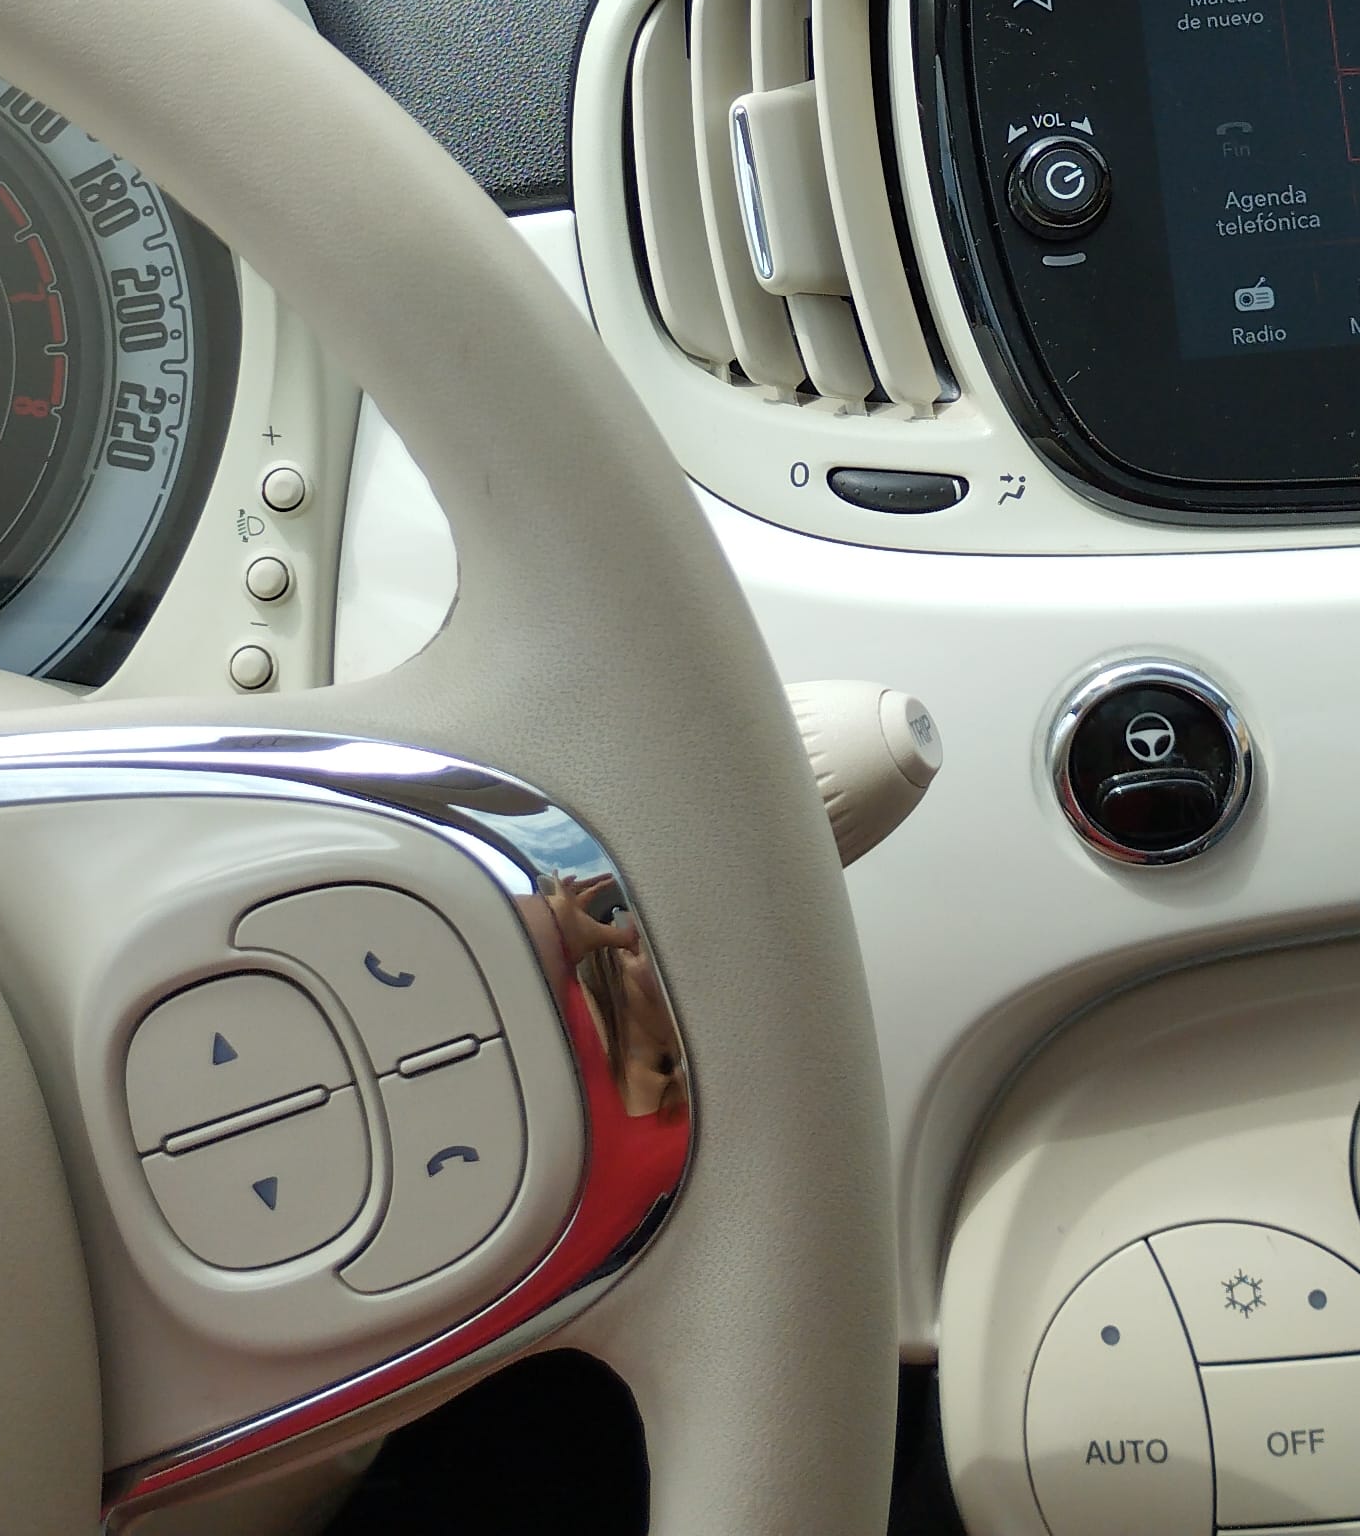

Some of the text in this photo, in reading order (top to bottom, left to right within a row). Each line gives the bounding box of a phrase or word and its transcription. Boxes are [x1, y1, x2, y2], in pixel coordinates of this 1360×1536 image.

[1177, 9, 1264, 31] de nuevo
[1032, 113, 1066, 131] VOL
[69, 159, 141, 238] 180
[1224, 184, 1307, 215] Agenda
[1216, 210, 1320, 237] telefónica
[110, 263, 168, 353] 200
[1232, 324, 1287, 346] Radio
[106, 380, 167, 472] 220
[790, 462, 809, 487] 0
[908, 713, 934, 748] TRIP
[1085, 1439, 1169, 1465] AUTO
[1266, 1428, 1325, 1457] OFF
